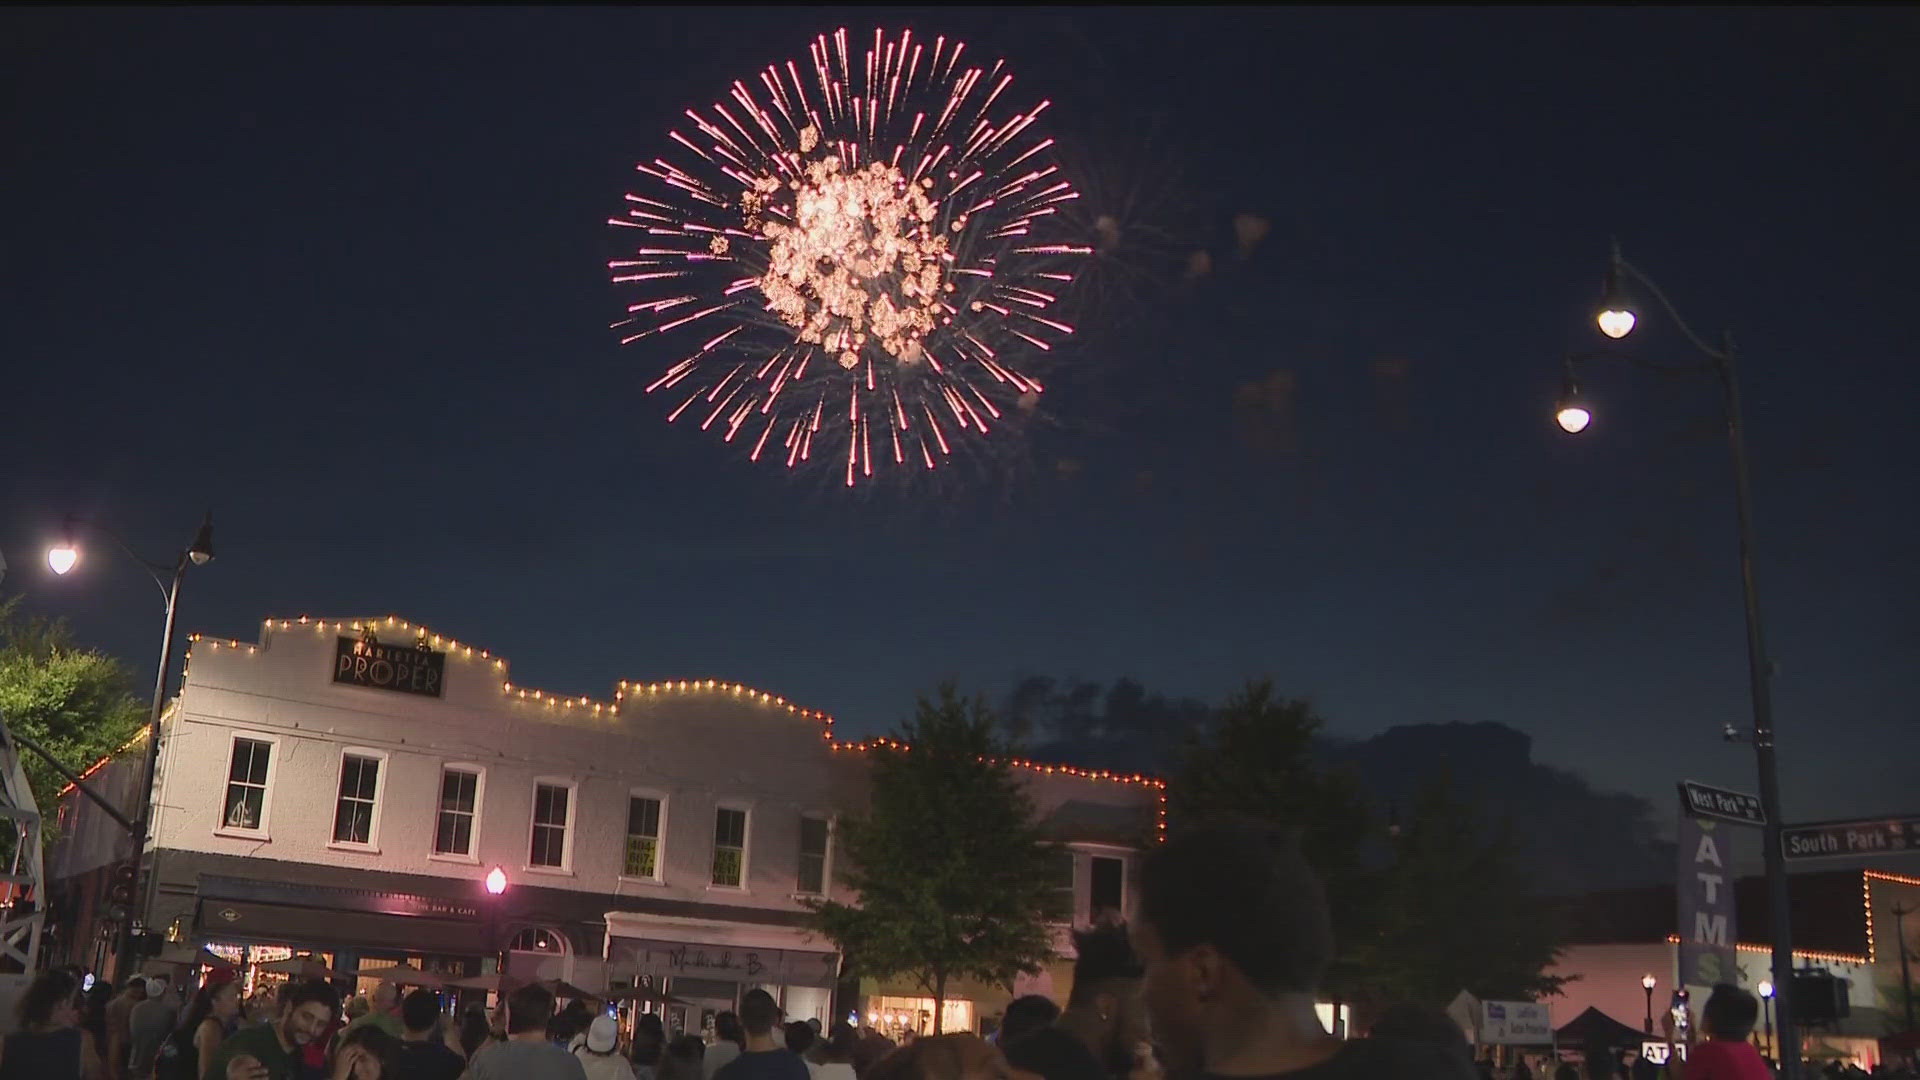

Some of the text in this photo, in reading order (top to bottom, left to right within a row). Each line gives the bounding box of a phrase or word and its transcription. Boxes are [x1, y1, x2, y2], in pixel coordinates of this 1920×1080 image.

[353, 641, 430, 666] MARIETTA
[338, 654, 438, 693] PROPER
[1689, 788, 1715, 809] West
[1715, 793, 1739, 813] Park
[1791, 833, 1838, 854] South
[1847, 829, 1886, 850] Park
